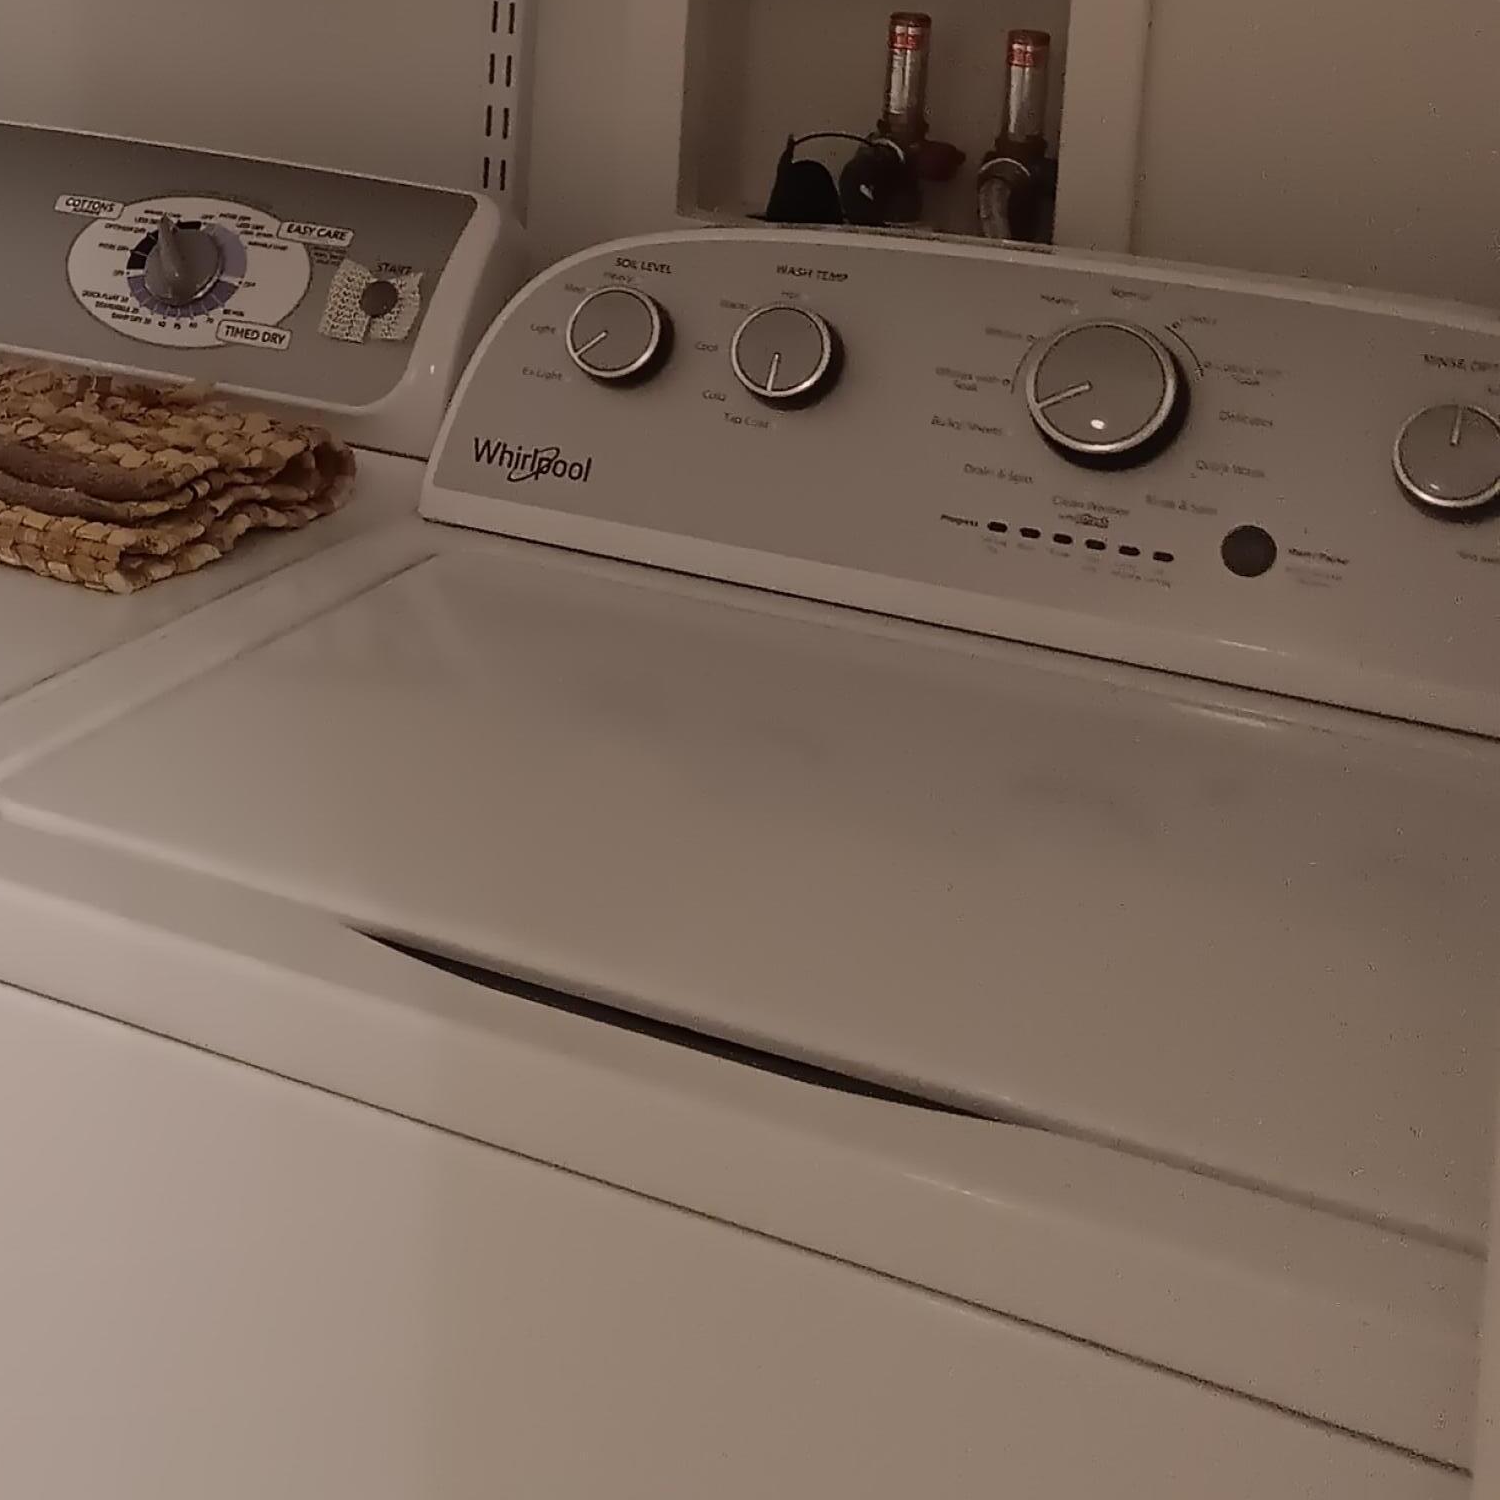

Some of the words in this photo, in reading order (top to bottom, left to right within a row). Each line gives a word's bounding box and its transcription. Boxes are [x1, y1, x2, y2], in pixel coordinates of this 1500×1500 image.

[65, 197, 115, 213] COTTONS
[287, 223, 316, 236] EASY
[317, 228, 347, 241] CARE
[376, 261, 412, 275] START
[640, 261, 672, 275] LEVEL
[776, 265, 813, 279] WASH
[816, 270, 849, 282] TEMP
[225, 325, 260, 340] TIMED
[262, 331, 286, 345] DRY
[701, 389, 727, 402] Cold
[473, 437, 593, 482] Whirlpool
